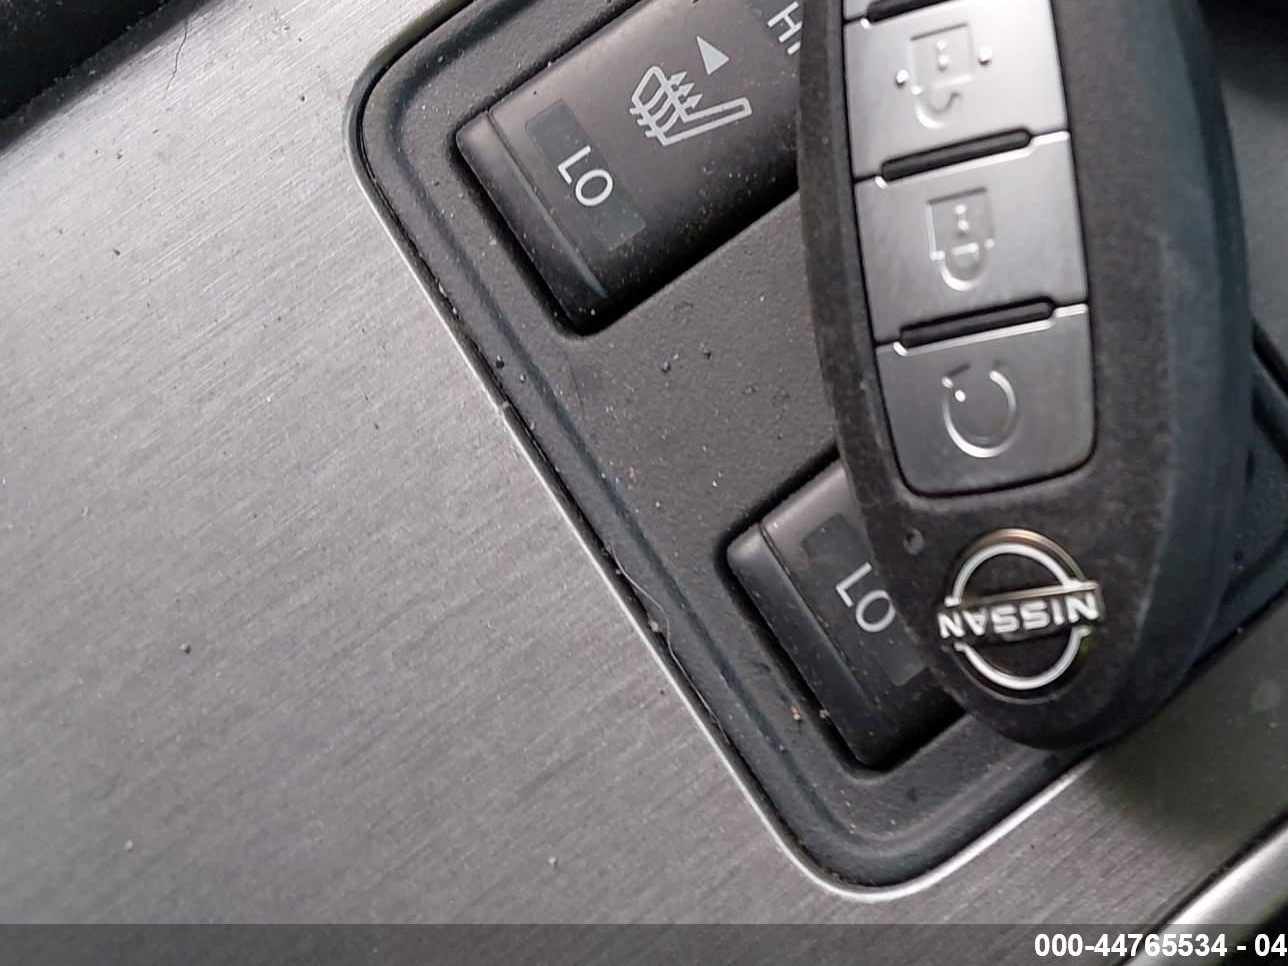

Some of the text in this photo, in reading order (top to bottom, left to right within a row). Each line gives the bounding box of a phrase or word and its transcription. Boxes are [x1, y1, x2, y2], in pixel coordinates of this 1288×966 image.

[557, 145, 614, 207] LO
[835, 561, 896, 633] LO
[937, 586, 1100, 640] NISSAN
